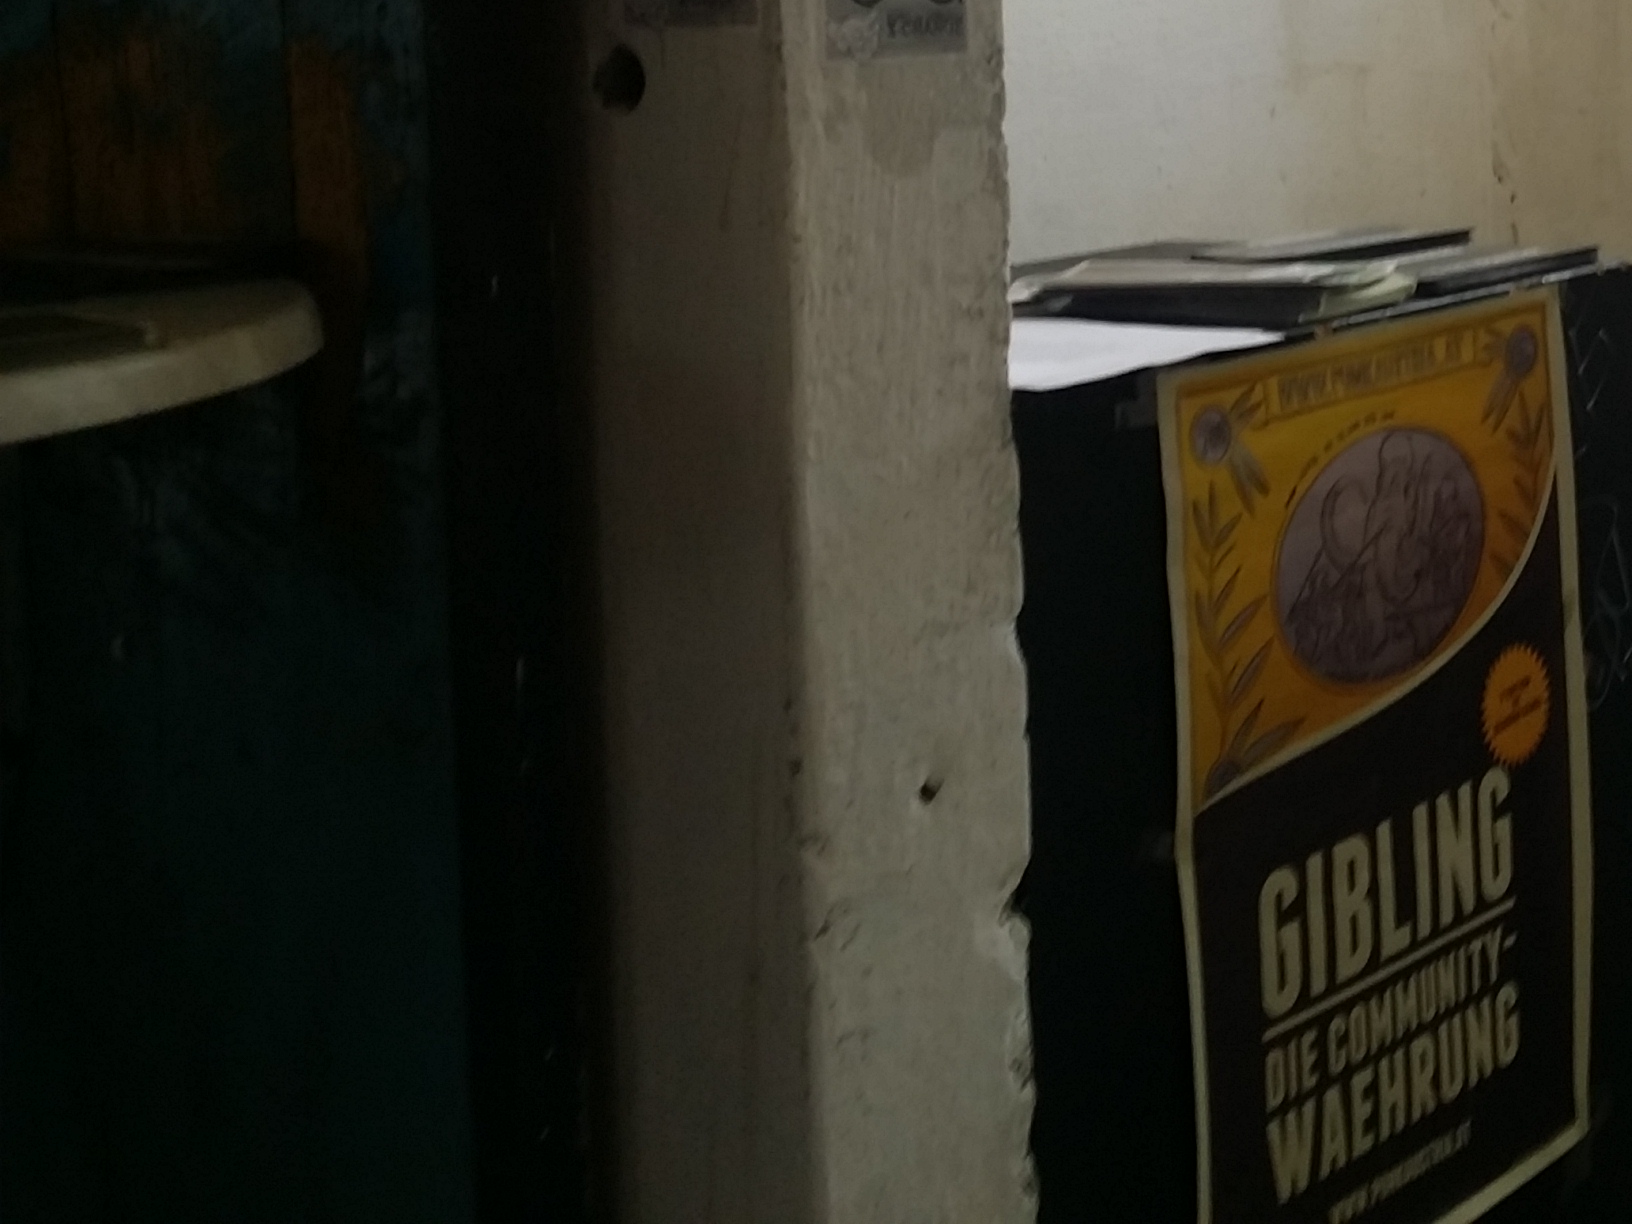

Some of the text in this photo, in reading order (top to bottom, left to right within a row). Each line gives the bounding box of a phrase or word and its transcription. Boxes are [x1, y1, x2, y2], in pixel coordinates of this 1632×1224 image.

[1259, 766, 1513, 1018] GIBLING
[1265, 922, 1518, 1113] DIE COMMUNITY-
[1266, 980, 1521, 1205] WAEHRUNG
